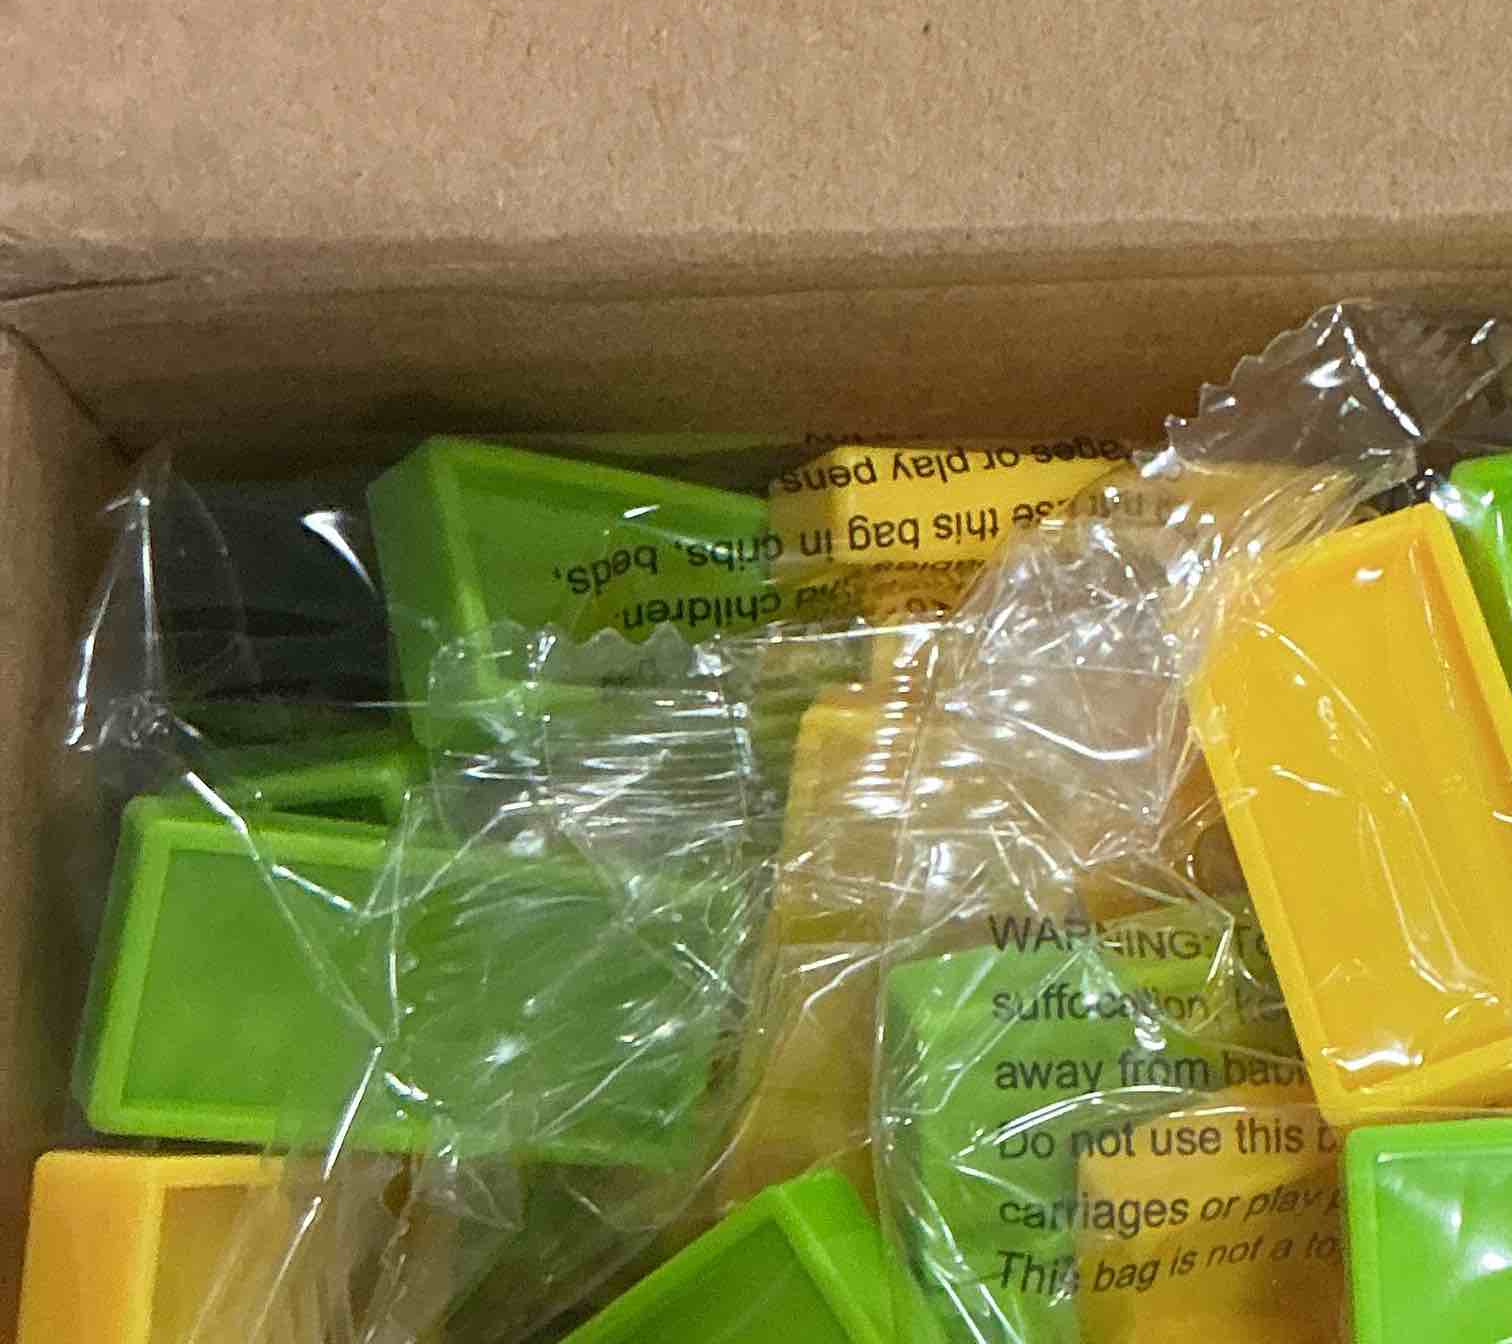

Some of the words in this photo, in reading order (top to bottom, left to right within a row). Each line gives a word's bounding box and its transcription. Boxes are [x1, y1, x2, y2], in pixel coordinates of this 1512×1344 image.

[890, 449, 970, 483] play
[982, 443, 1023, 470] or
[1030, 436, 1132, 465] ages
[849, 514, 920, 551] bag
[932, 506, 998, 540] this
[800, 528, 833, 563] in
[552, 545, 659, 597] beds,
[613, 591, 782, 631] children.
[995, 1058, 1104, 1092] away
[1119, 1049, 1209, 1088] from
[998, 1123, 1054, 1160] Do
[1071, 1120, 1136, 1158] not
[1150, 1125, 1222, 1156] use
[1235, 1117, 1305, 1155] this
[999, 1190, 1189, 1238] carriages
[1200, 1195, 1240, 1223] or
[1243, 1187, 1321, 1224] play
[1093, 1258, 1160, 1293] bag
[1169, 1247, 1195, 1277] is
[1206, 1232, 1262, 1266] not
[1268, 1237, 1293, 1263] a
